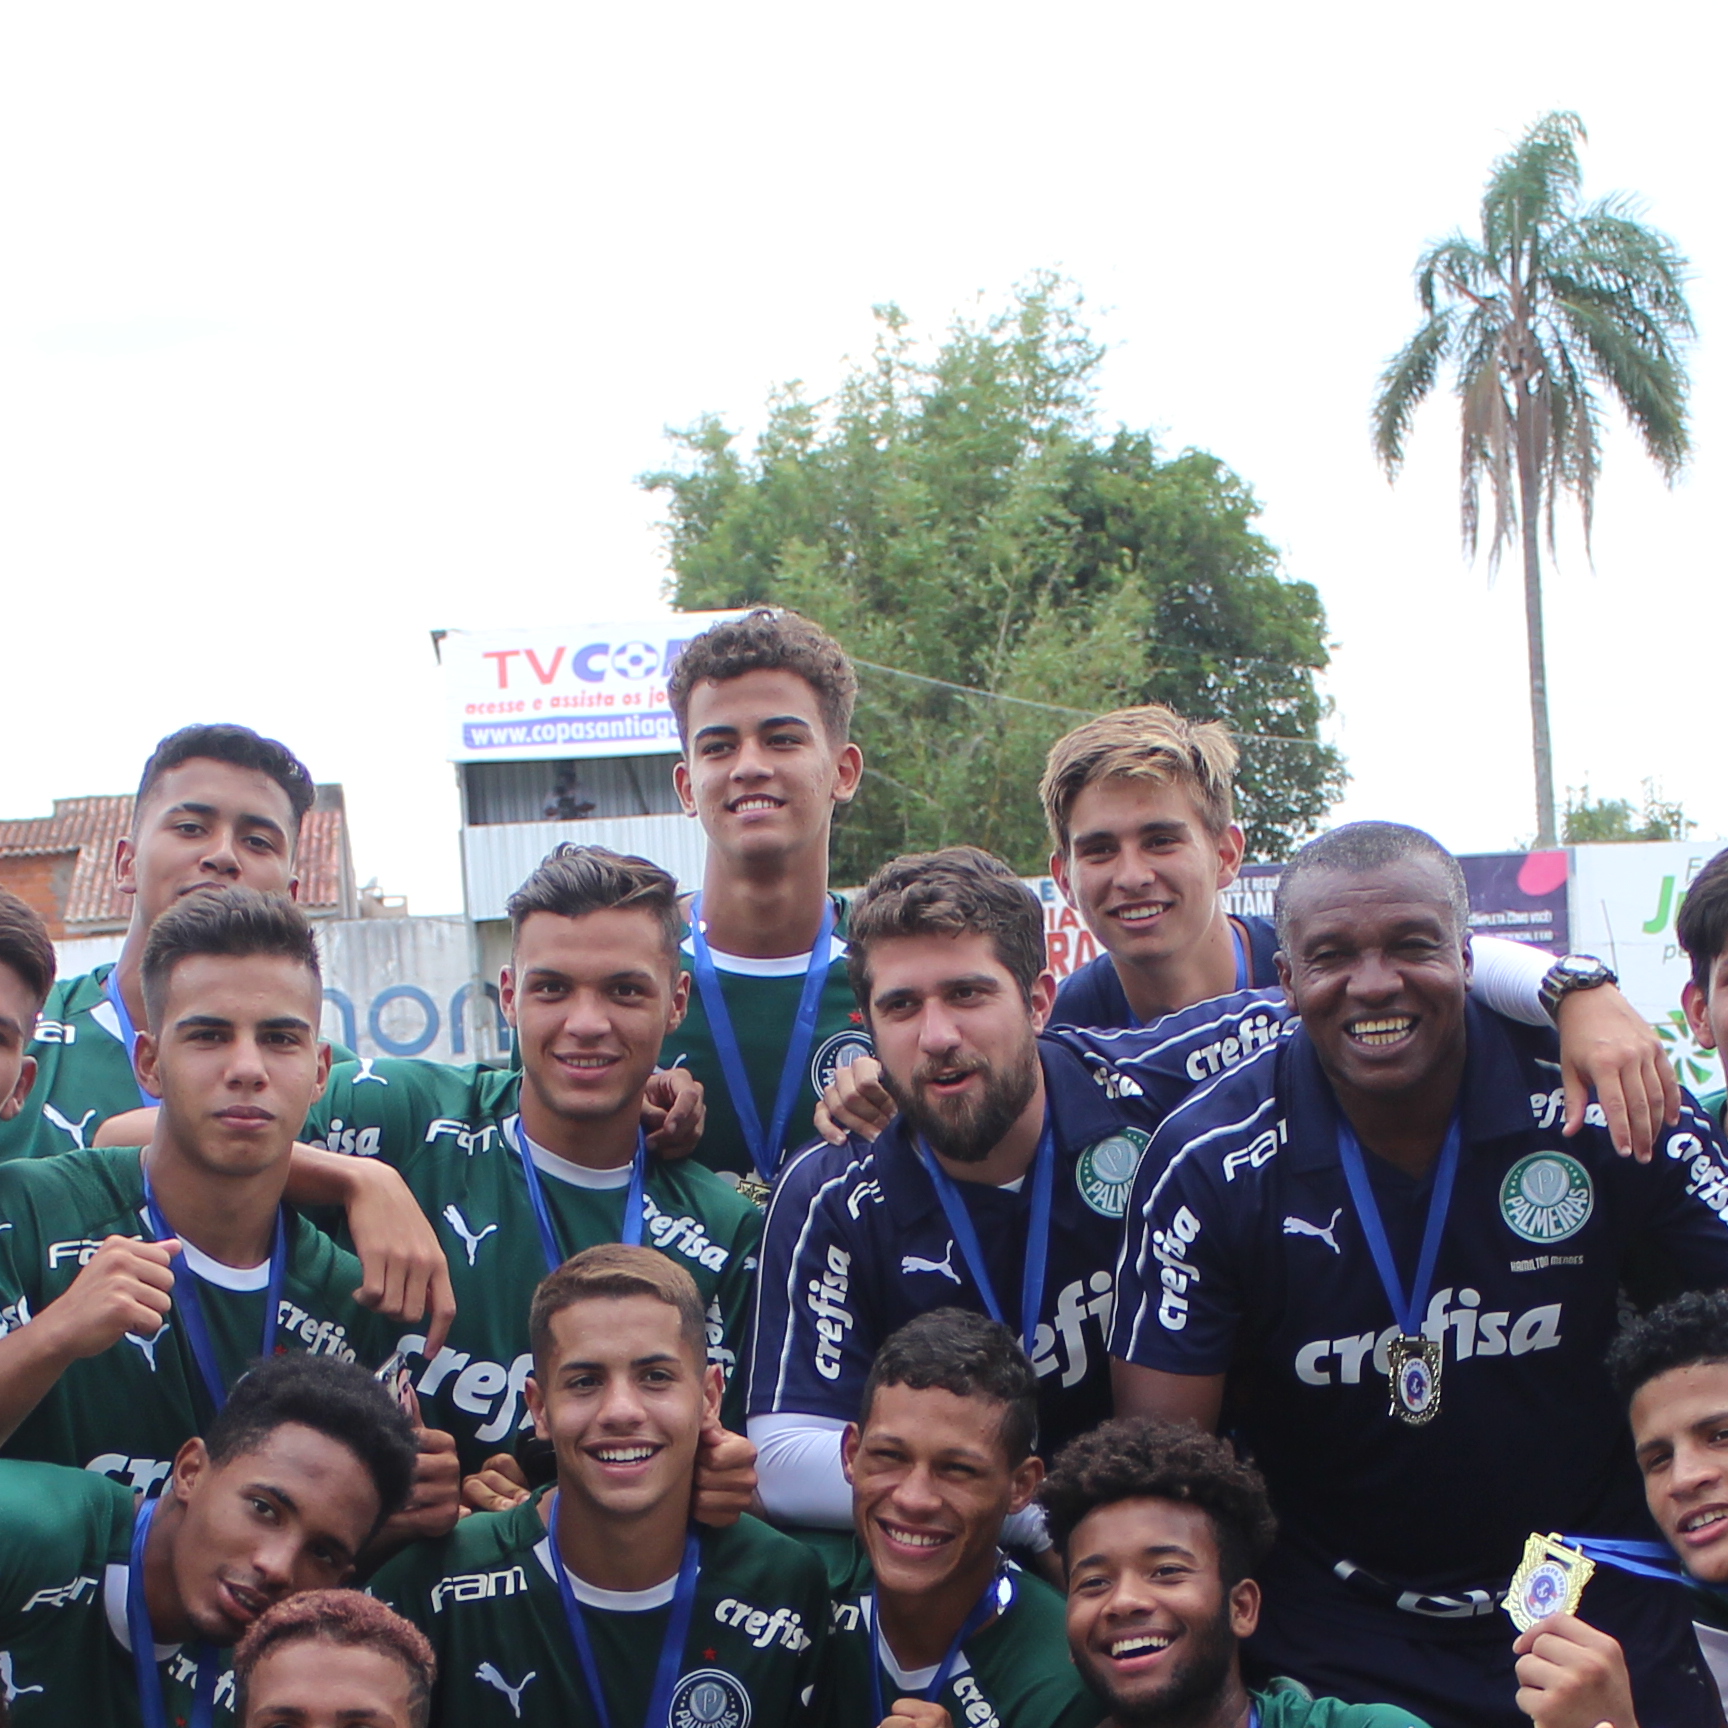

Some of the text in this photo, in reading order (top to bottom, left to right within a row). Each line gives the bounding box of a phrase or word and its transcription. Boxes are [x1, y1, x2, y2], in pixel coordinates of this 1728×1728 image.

[549, 690, 615, 709] assista
[622, 692, 642, 705] os
[1506, 1187, 1589, 1240] PALMEIRAS
[807, 1244, 853, 1381] crefisa
[1158, 1205, 1202, 1332] crefisa
